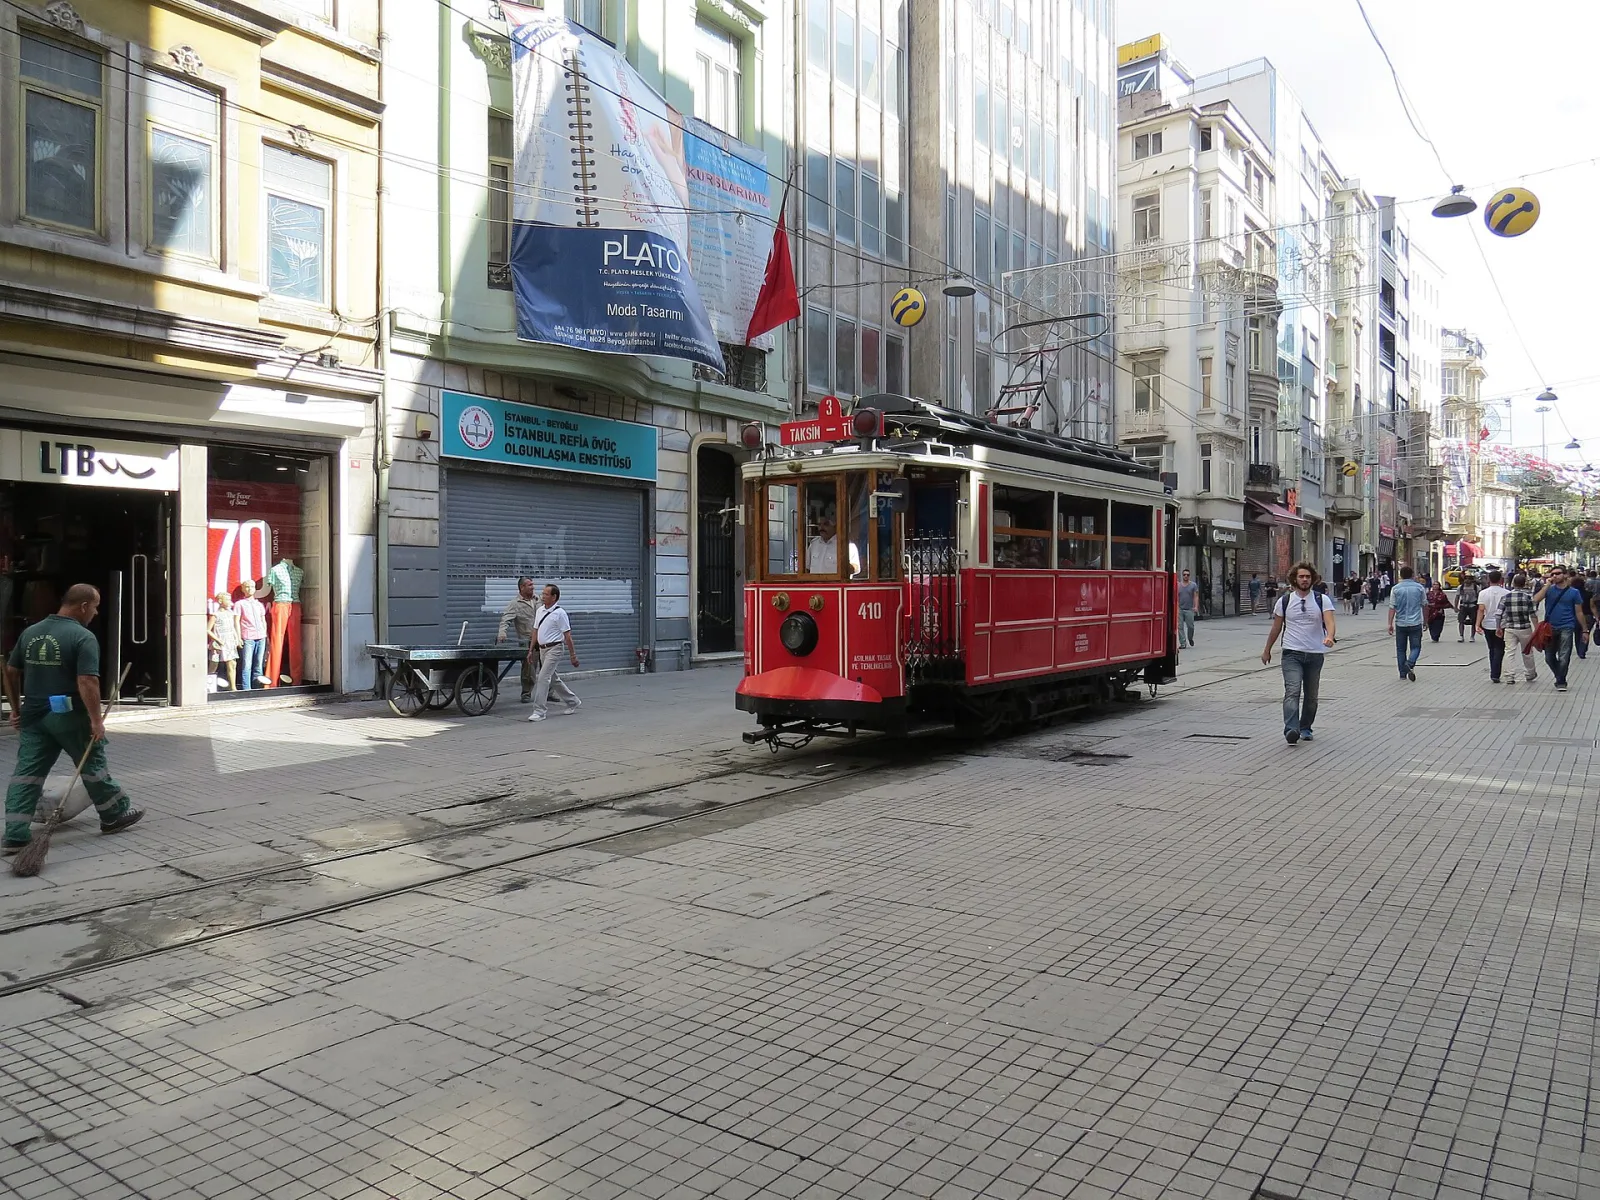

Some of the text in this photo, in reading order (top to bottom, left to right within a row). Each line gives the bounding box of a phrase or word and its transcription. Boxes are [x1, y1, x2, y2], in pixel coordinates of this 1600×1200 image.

[603, 235, 681, 274] PLATO
[607, 303, 684, 321] Moda Tasarımı
[583, 328, 607, 337] (PMYO)
[609, 331, 656, 339] www.plato.edu.tr
[825, 399, 833, 416] 3
[504, 411, 541, 427] İSTANBUL
[546, 419, 579, 432] BEYOĞLU
[504, 423, 617, 453] İSTANBUL REFİA ÖVÜÇ
[789, 423, 821, 443] TAKSİM
[40, 440, 96, 477] LTB
[504, 442, 632, 470] OLGUNLAŞMA ENSTİTÜSÜ
[226, 491, 236, 499] The
[229, 499, 236, 507] of
[208, 518, 272, 598] 70
[857, 602, 882, 620] 410
[853, 654, 876, 662] ASILMAK
